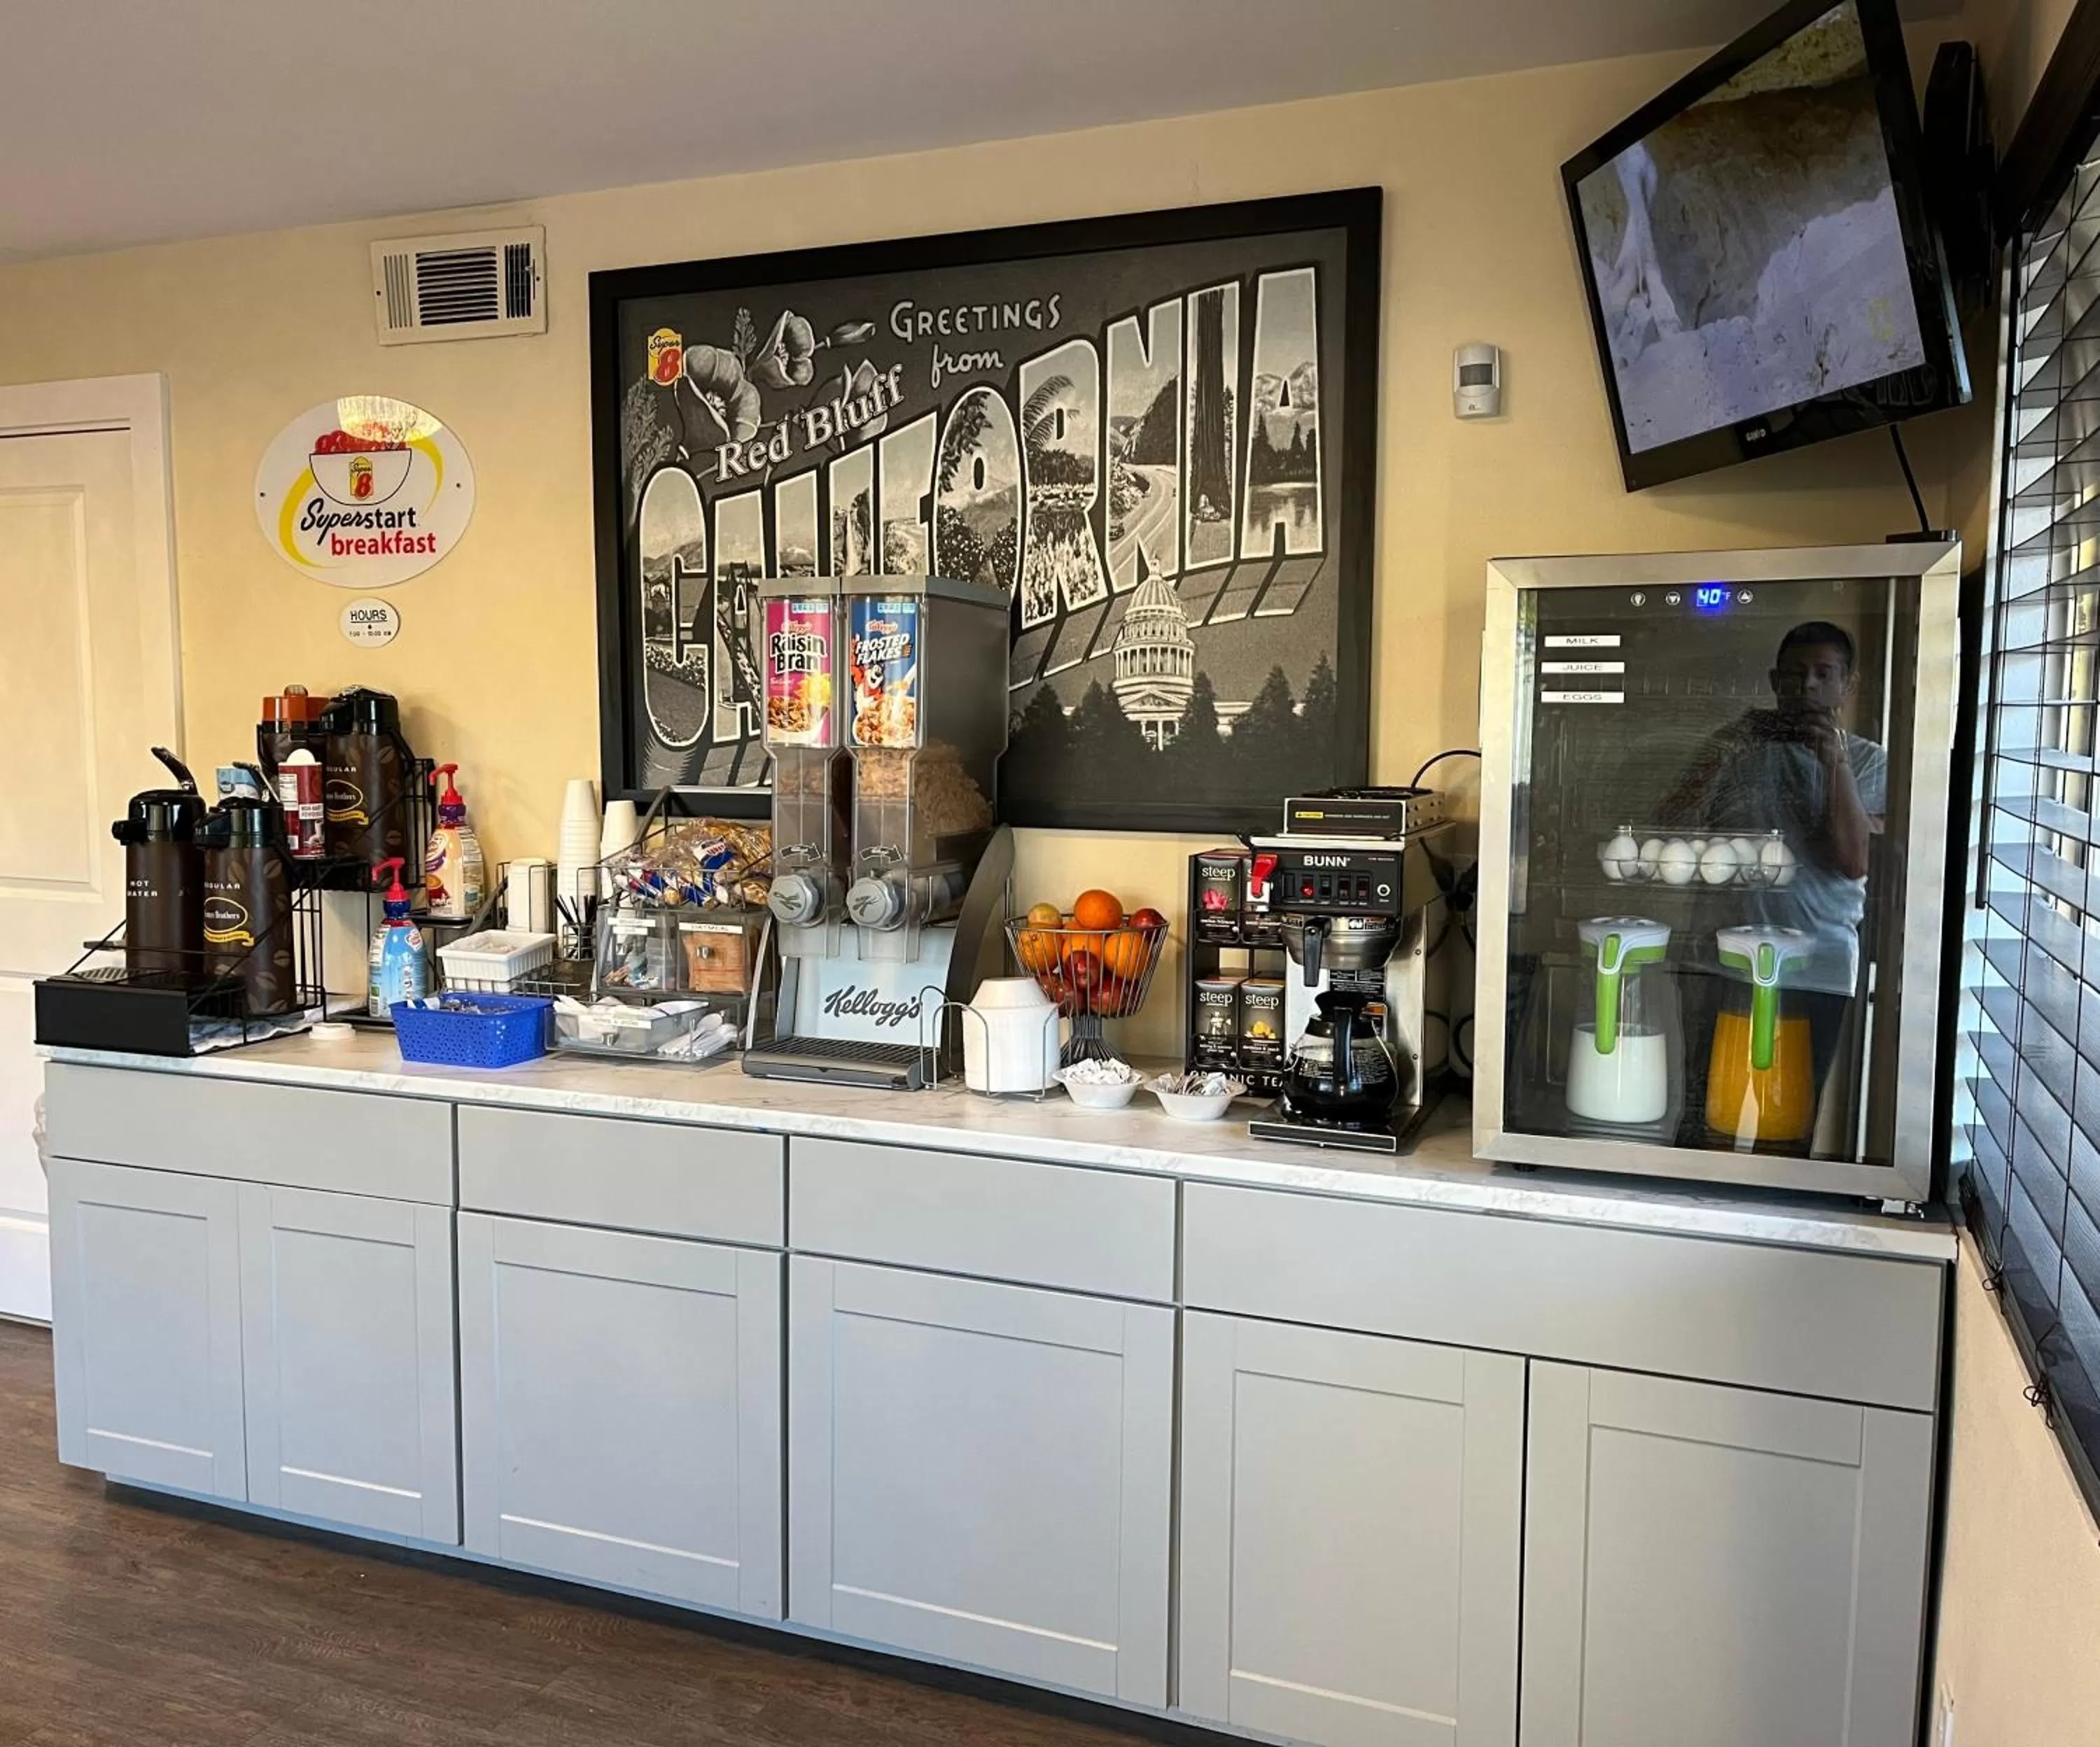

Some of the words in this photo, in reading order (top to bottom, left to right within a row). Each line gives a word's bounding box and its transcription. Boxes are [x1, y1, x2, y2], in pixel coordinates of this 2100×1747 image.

[890, 294, 1062, 343] GREETINGS
[657, 348, 681, 382] 8
[930, 345, 1005, 389] from
[715, 421, 793, 482] Red
[801, 363, 904, 451] Bluff
[356, 472, 372, 498] 8
[300, 498, 417, 546] Superstart
[330, 531, 437, 556] breakfast
[350, 609, 387, 622] HOURS
[771, 633, 827, 657] Raisin
[855, 633, 910, 654] FROSTED
[776, 653, 821, 674] Bran
[856, 646, 902, 666] FLAKES
[1201, 865, 1236, 881] steep
[1303, 855, 1348, 867] BUNN
[824, 984, 921, 1027] Kellogg's
[1199, 991, 1233, 1007] steep
[1245, 994, 1280, 1010] steep
